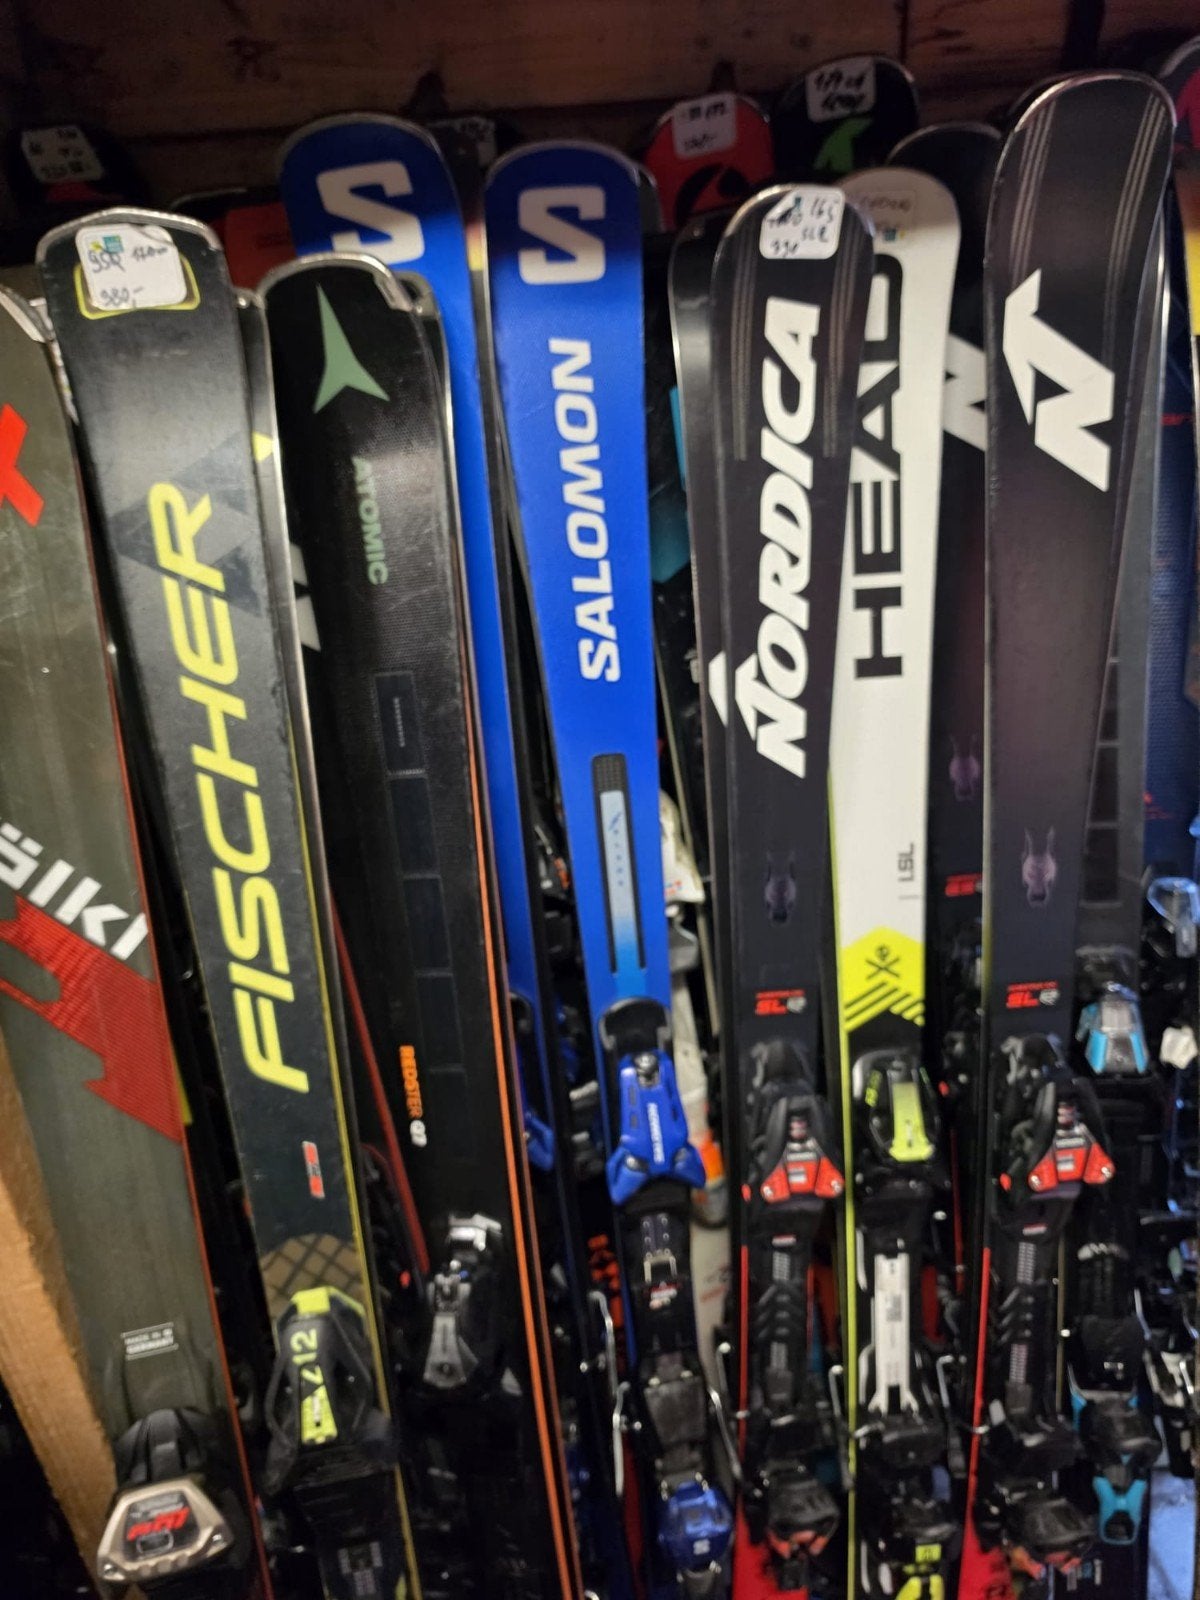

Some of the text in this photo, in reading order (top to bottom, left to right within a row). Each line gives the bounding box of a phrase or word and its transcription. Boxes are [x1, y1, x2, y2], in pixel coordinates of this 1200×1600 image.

[518, 185, 606, 285] S
[352, 456, 389, 585] ATOMIC
[548, 337, 621, 683] SALOMON
[734, 296, 821, 779] NORDICA
[850, 253, 905, 681] HEAD
[148, 482, 310, 1094] FISCHER
